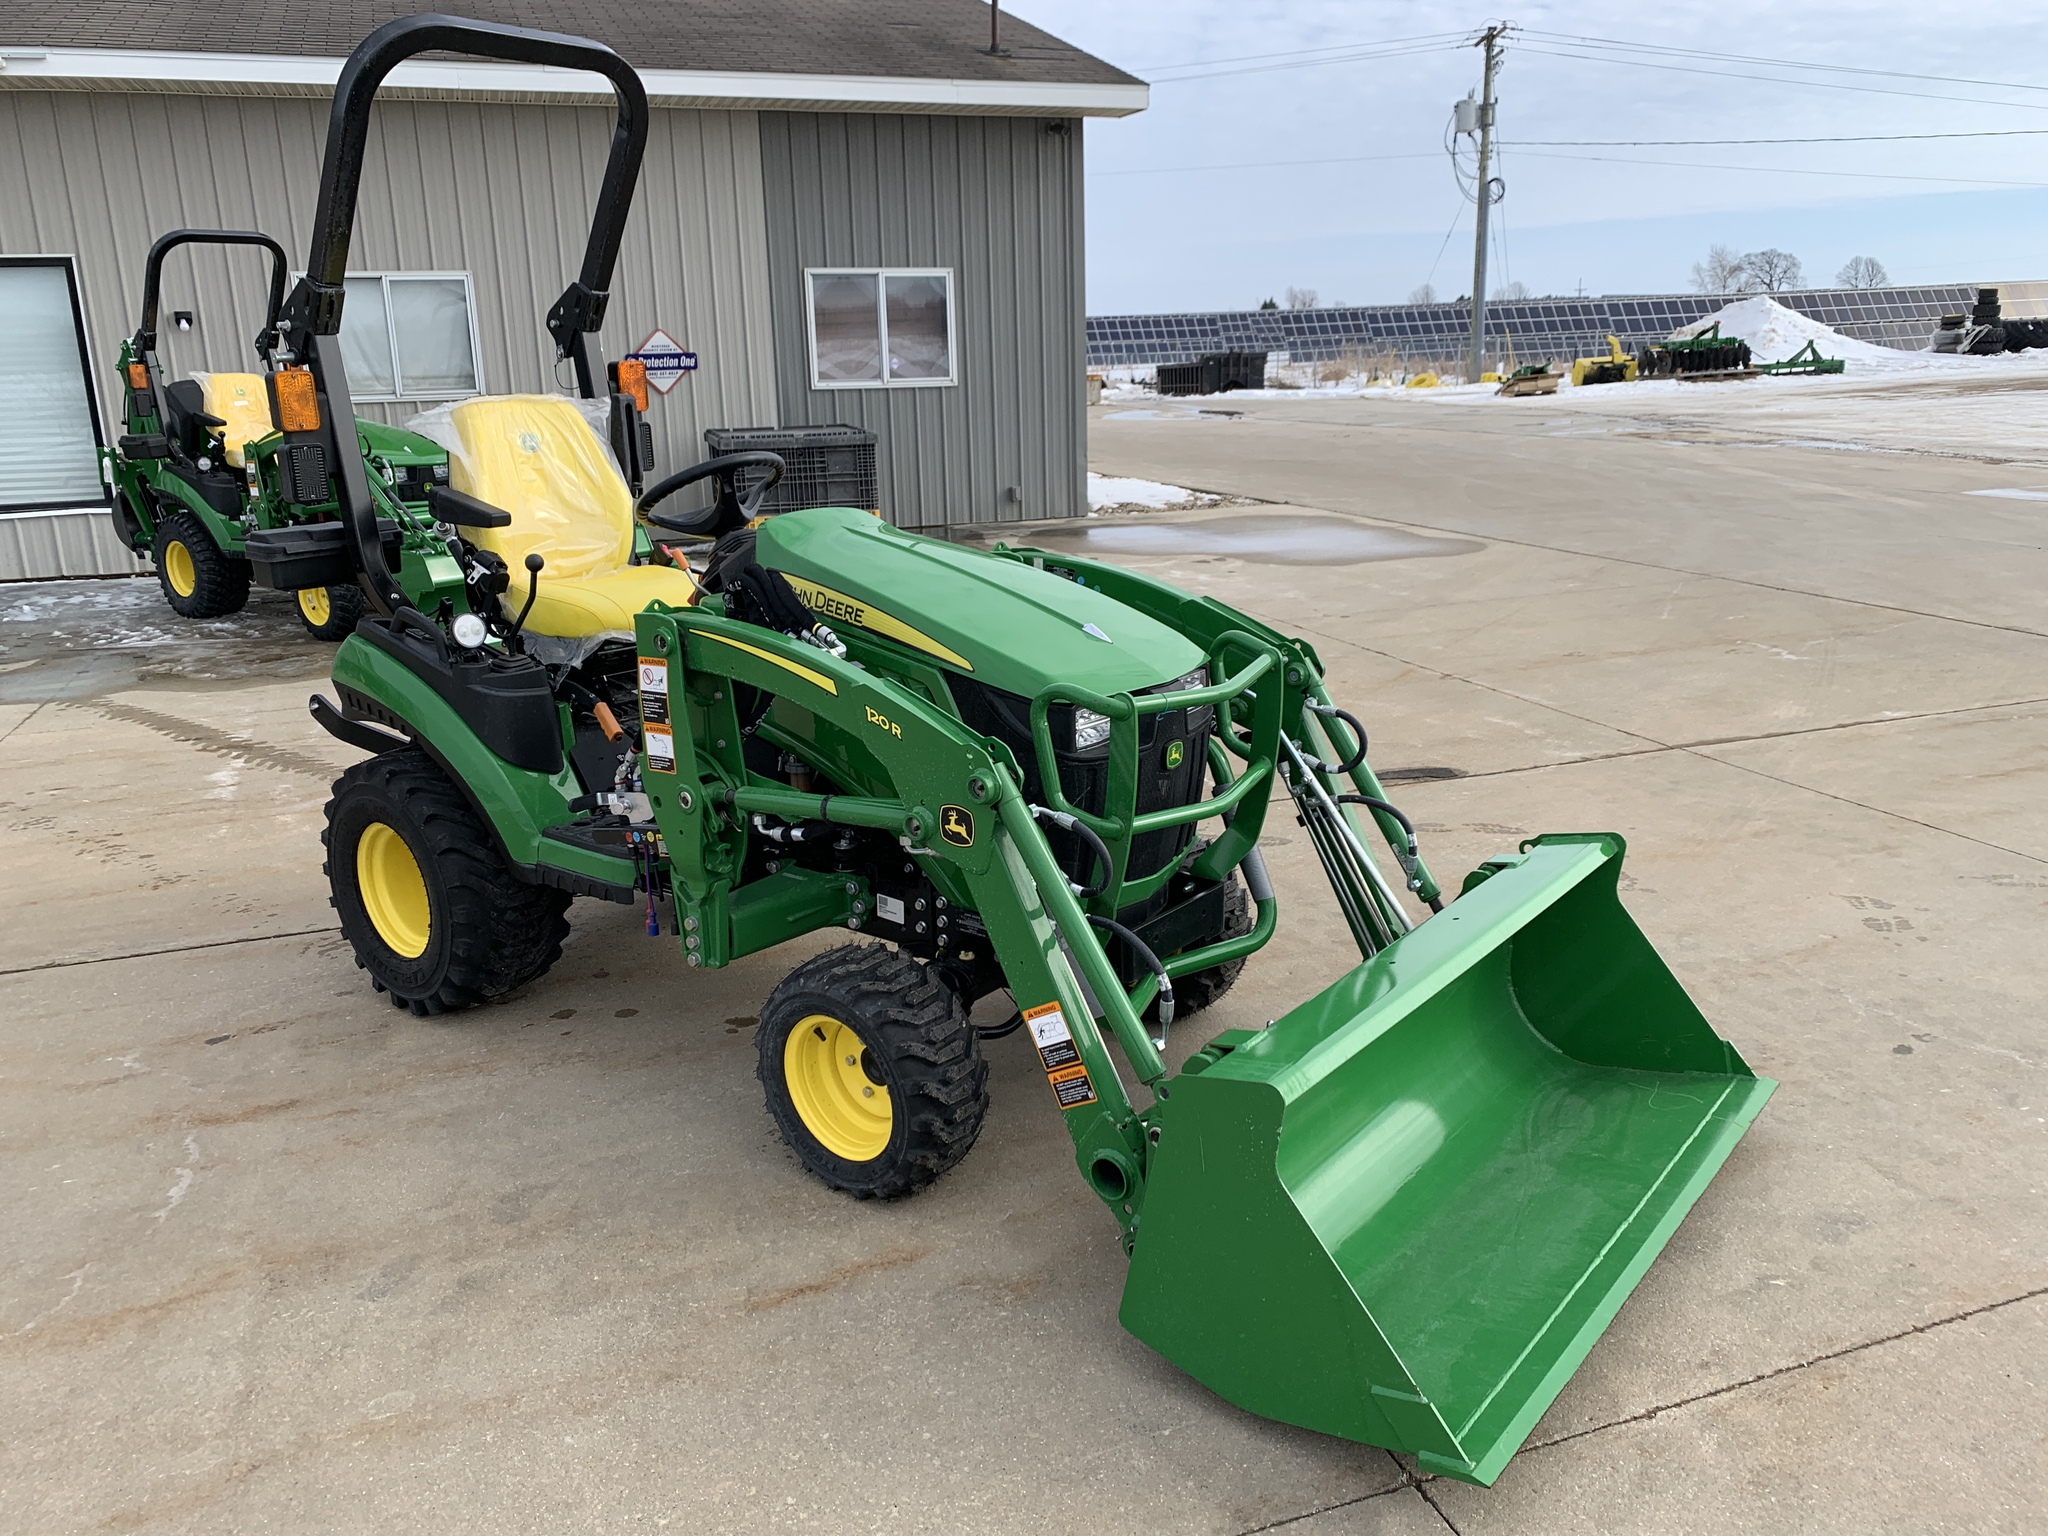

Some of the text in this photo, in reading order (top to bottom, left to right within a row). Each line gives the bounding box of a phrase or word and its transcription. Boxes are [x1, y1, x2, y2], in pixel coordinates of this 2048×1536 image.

[638, 356, 695, 368] Protection One
[814, 590, 865, 624] DEERE
[644, 658, 666, 667] WARNING
[864, 705, 902, 740] 120 R
[649, 725, 671, 735] WARNING
[1033, 1004, 1057, 1017] WARNING
[1059, 1069, 1083, 1081] WARNING
